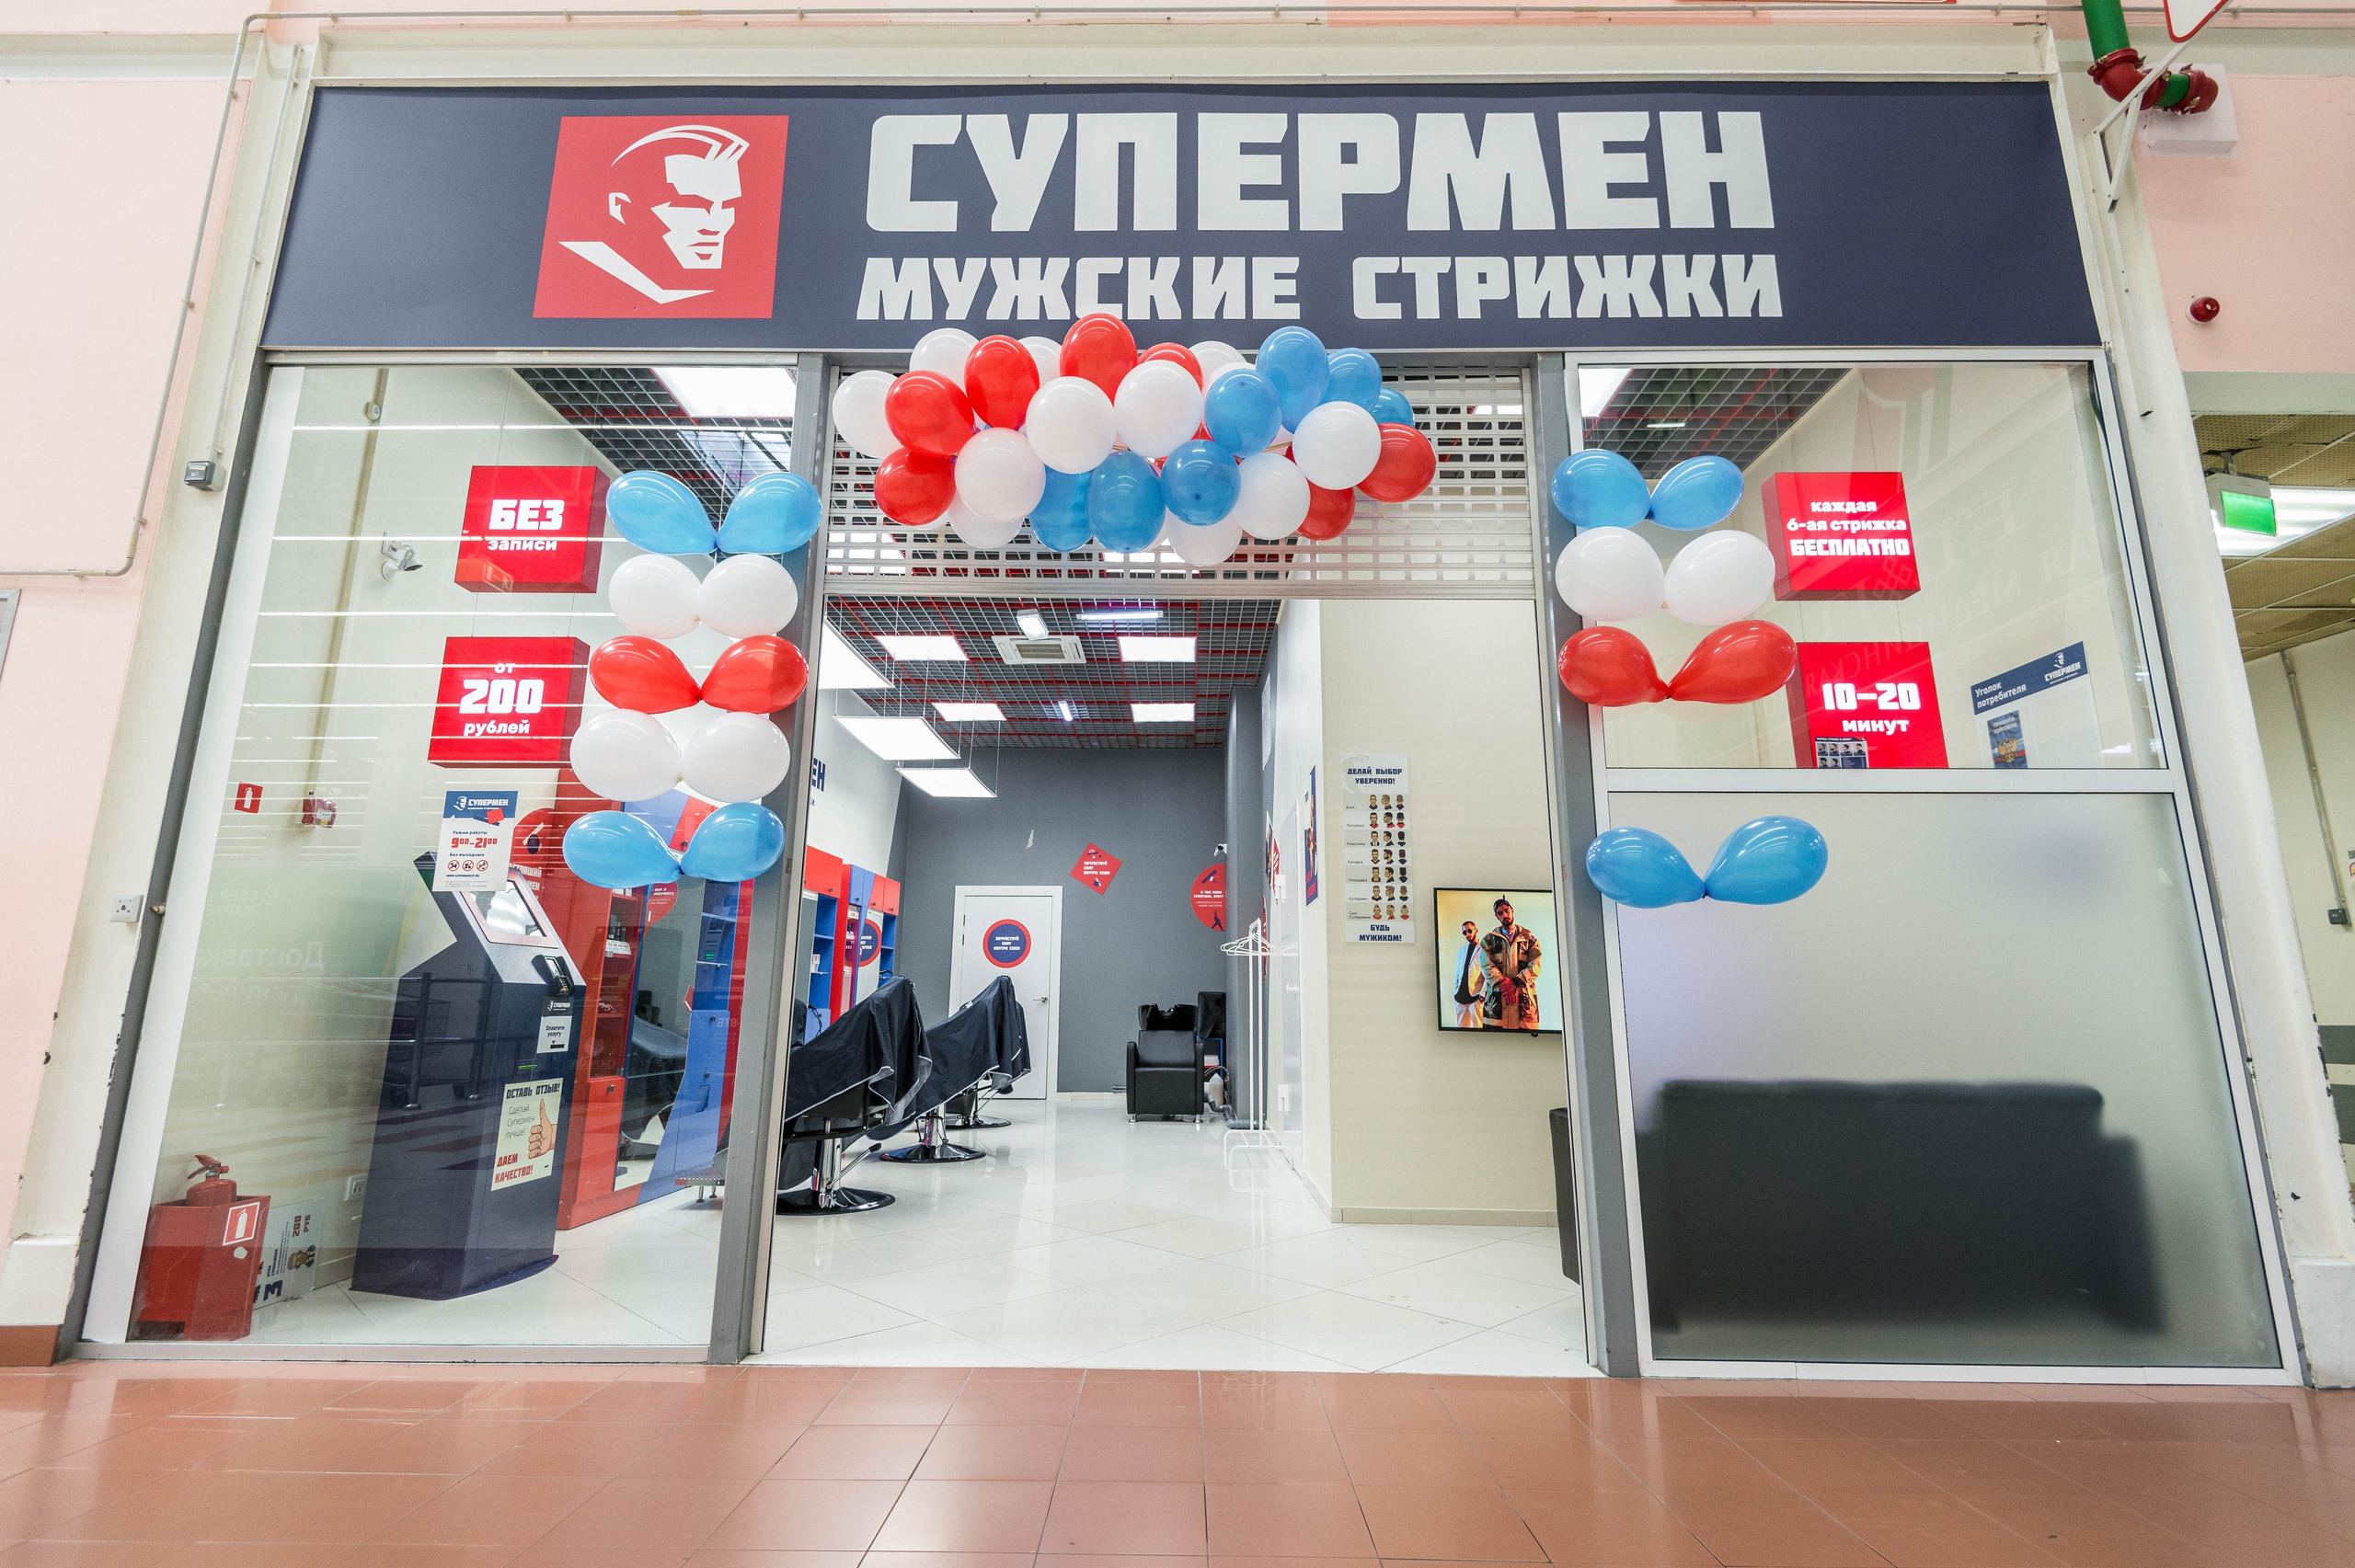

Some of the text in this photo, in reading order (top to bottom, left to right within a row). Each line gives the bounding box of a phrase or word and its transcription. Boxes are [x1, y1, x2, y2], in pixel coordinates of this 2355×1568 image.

[866, 110, 1775, 233] СУПЕРМЕН
[856, 254, 1783, 321] МУЖСКИЕ СТРИЖКИ
[488, 498, 565, 531] БЕЗ
[1810, 501, 1878, 513] каждая
[1786, 518, 1907, 533] 6-ая стрижка
[488, 539, 557, 551] записи
[1789, 538, 1911, 556] БЕСПЛАТНО
[494, 663, 515, 673] от
[2044, 661, 2081, 681] СУПЕРМЕН
[459, 679, 545, 714] 200
[1821, 682, 1922, 710] 10-20
[1974, 681, 2002, 697] Уголок
[1977, 684, 2027, 708] потребителя
[464, 719, 531, 737] рублей
[1842, 719, 1910, 736] минут
[1993, 716, 2016, 728] ПРАВИЛА
[1993, 722, 2017, 735] ТОРГОВЛИ
[1347, 766, 1372, 774] ДЕЛАЙ
[506, 1082, 560, 1099] ОСТАВЬ ОТЗЫВ!
[509, 1104, 530, 1115] Сделай
[507, 1116, 535, 1127] Супермен
[505, 1127, 526, 1139] лучше!
[497, 1153, 518, 1168] ДАЕМ
[495, 1165, 534, 1184] КАЧЕСТВО!
[293, 1215, 302, 1238] 200
